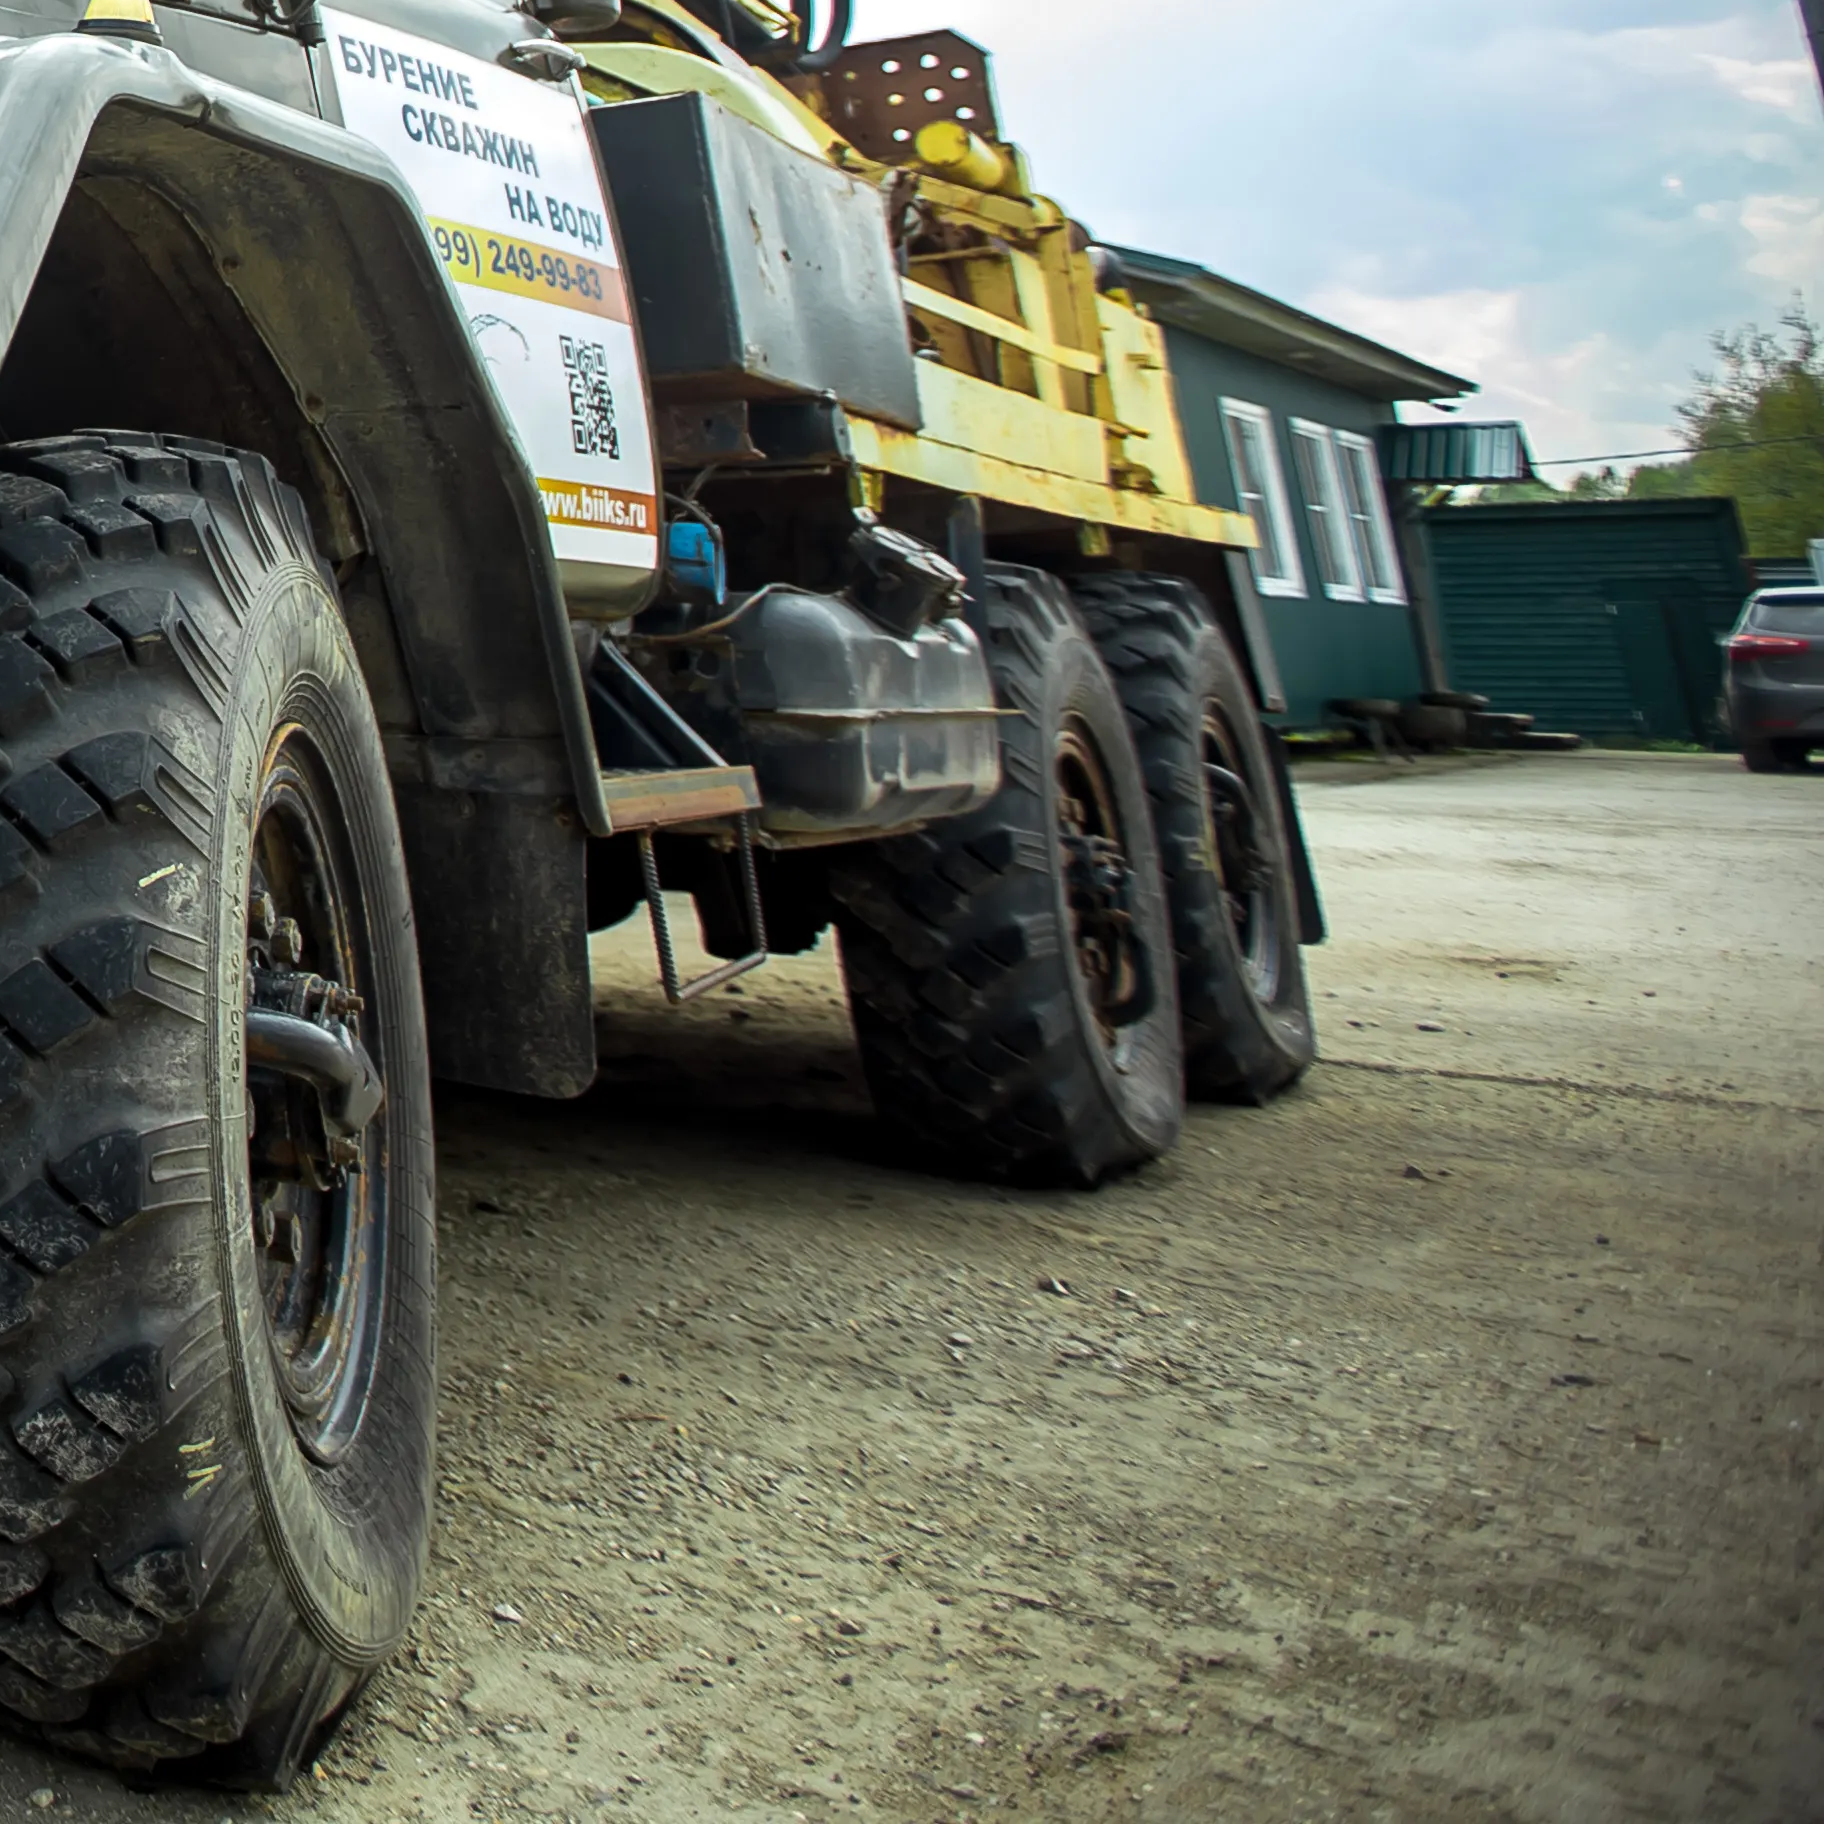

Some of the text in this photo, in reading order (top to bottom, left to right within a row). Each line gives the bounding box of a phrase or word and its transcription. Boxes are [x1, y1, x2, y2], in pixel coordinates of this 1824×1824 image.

[338, 35, 479, 111] БУРЕНИЕ
[402, 104, 541, 179] СКВАЖИН
[504, 182, 603, 252] НА ВОДУ
[434, 226, 603, 301] 99) 249-99-83
[539, 486, 647, 528] ww.biiks.ru
